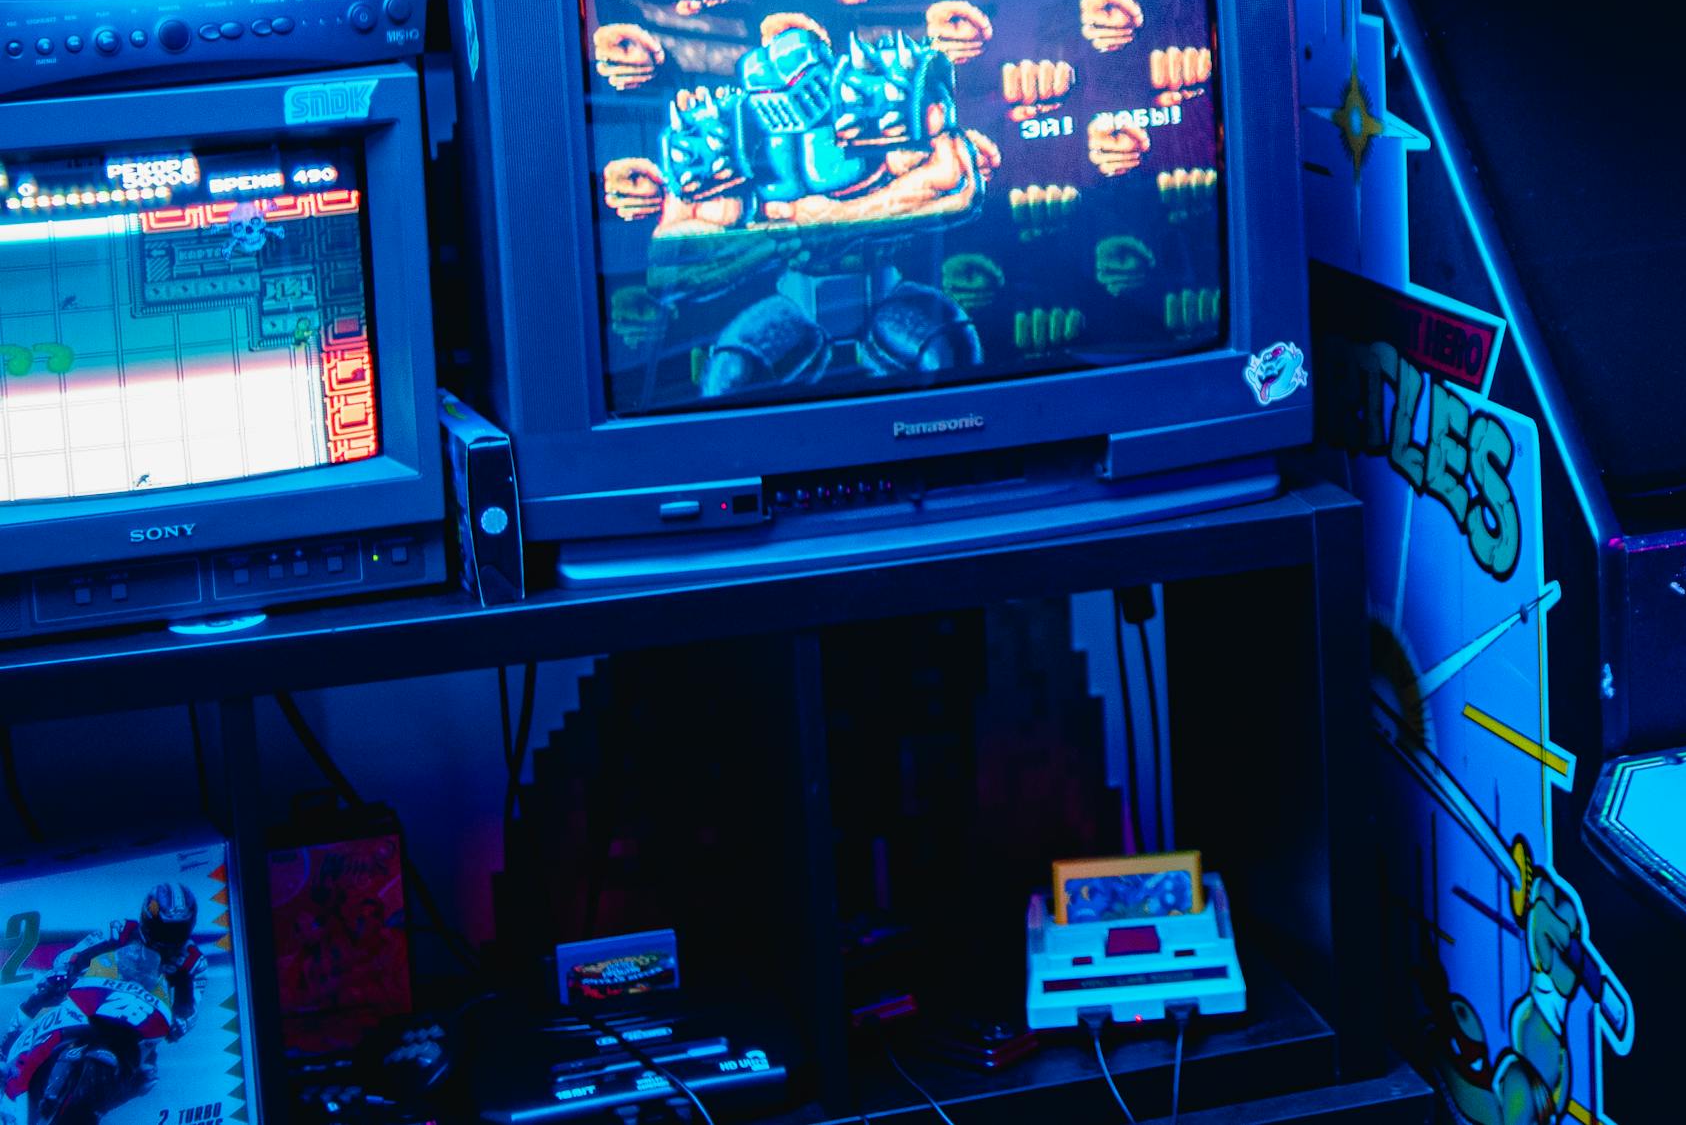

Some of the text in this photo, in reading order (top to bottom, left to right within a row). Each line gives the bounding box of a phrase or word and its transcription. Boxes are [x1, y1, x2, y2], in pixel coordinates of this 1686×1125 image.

[293, 167, 335, 185] 490
[1423, 315, 1483, 376] HERO
[892, 411, 985, 439] Panasonic
[129, 523, 196, 543] SONY
[178, 1102, 222, 1125] TURBO
